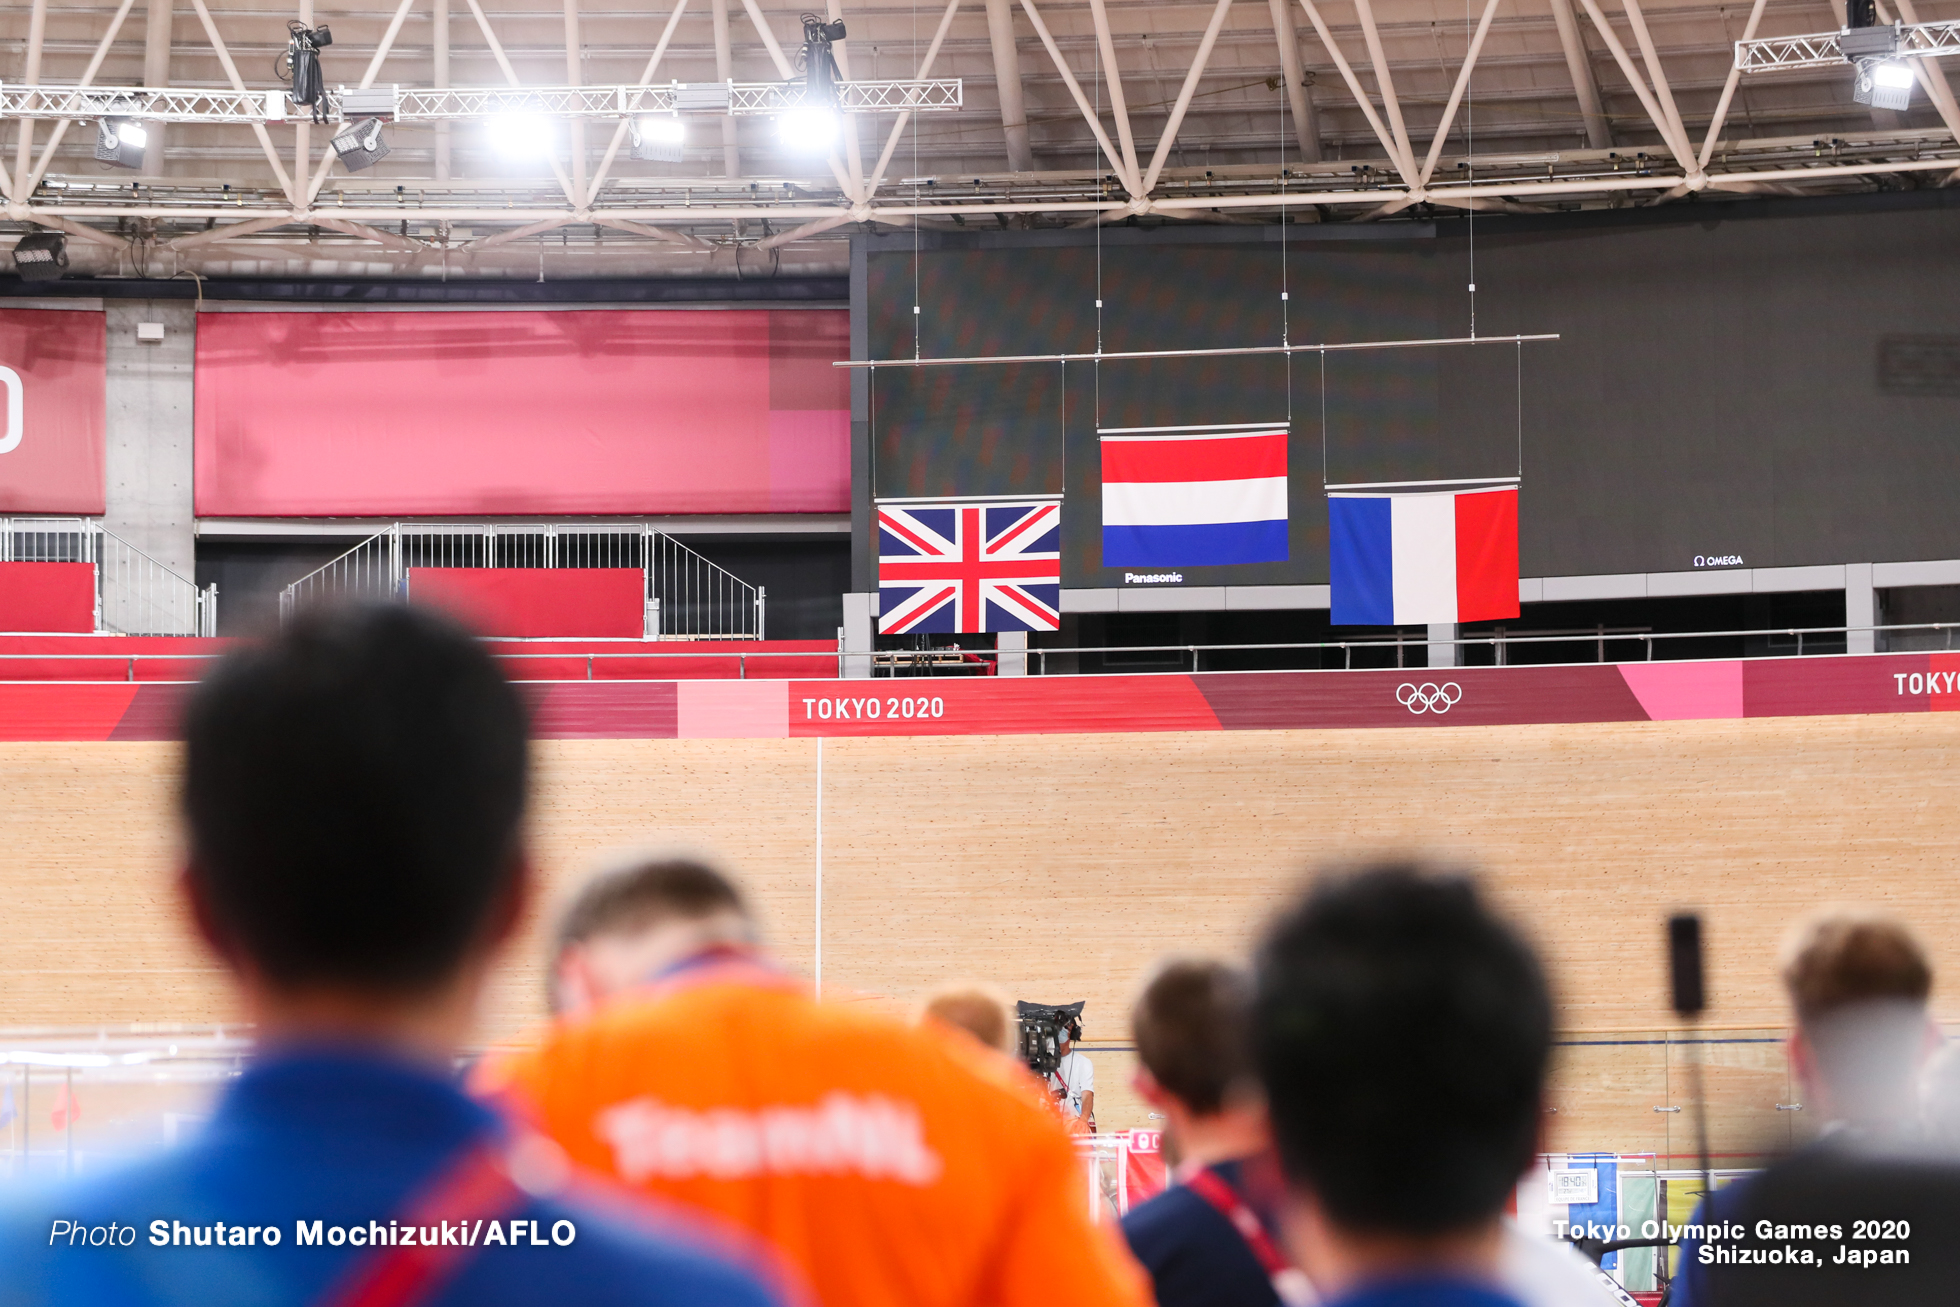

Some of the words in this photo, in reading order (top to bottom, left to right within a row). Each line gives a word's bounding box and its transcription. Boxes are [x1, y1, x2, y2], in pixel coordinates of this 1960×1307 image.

[1706, 555, 1744, 566] OMEGA
[1124, 571, 1183, 584] Panasonic
[1893, 671, 1960, 695] TOKY
[802, 698, 881, 719] TOKYO
[886, 697, 944, 718] 2020
